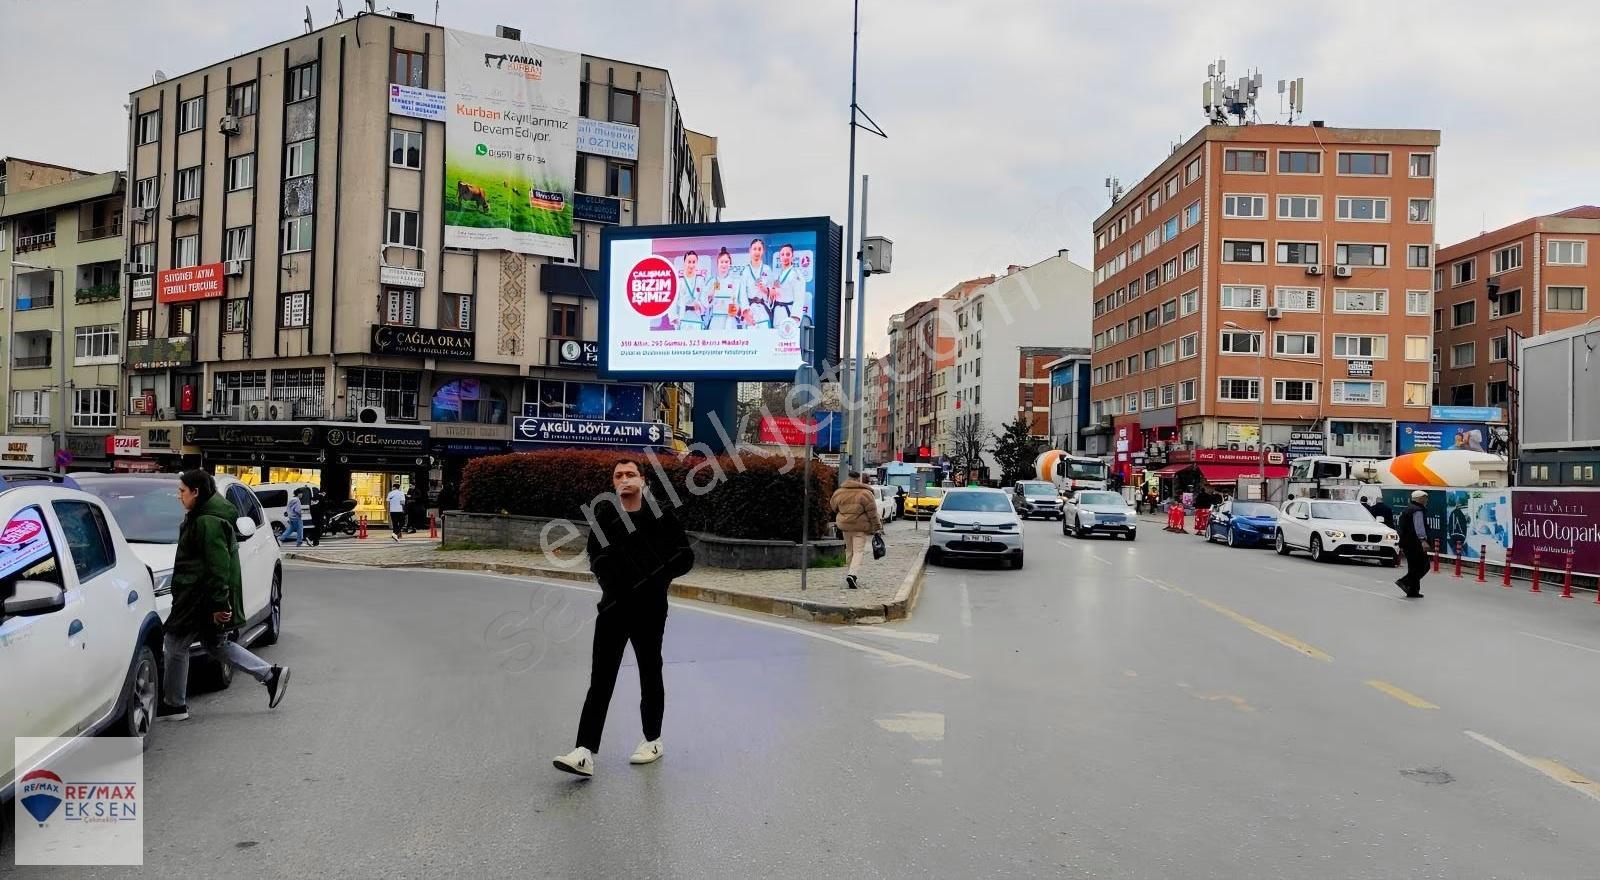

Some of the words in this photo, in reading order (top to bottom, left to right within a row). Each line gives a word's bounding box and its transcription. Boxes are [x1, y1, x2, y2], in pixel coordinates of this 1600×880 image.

[508, 54, 542, 67] YAMAN
[508, 63, 542, 74] KURBAN
[456, 103, 501, 120] Kurban
[504, 110, 569, 130] Kayıtlarımız
[473, 121, 514, 136] Devam
[632, 269, 672, 278] ÇALIŞMAK
[632, 278, 672, 290] BİZİM
[632, 290, 672, 305] İŞİMİZ
[397, 332, 435, 345] ÇAĞLA
[438, 336, 472, 348] ORAN
[584, 344, 598, 352] Ku
[586, 352, 598, 362] Fa
[540, 421, 576, 433] AKGÜL
[578, 422, 610, 436] DÖVİZ
[614, 426, 642, 436] ALTIN
[1514, 518, 1540, 538] Katlı
[1543, 519, 1600, 547] Otopark
